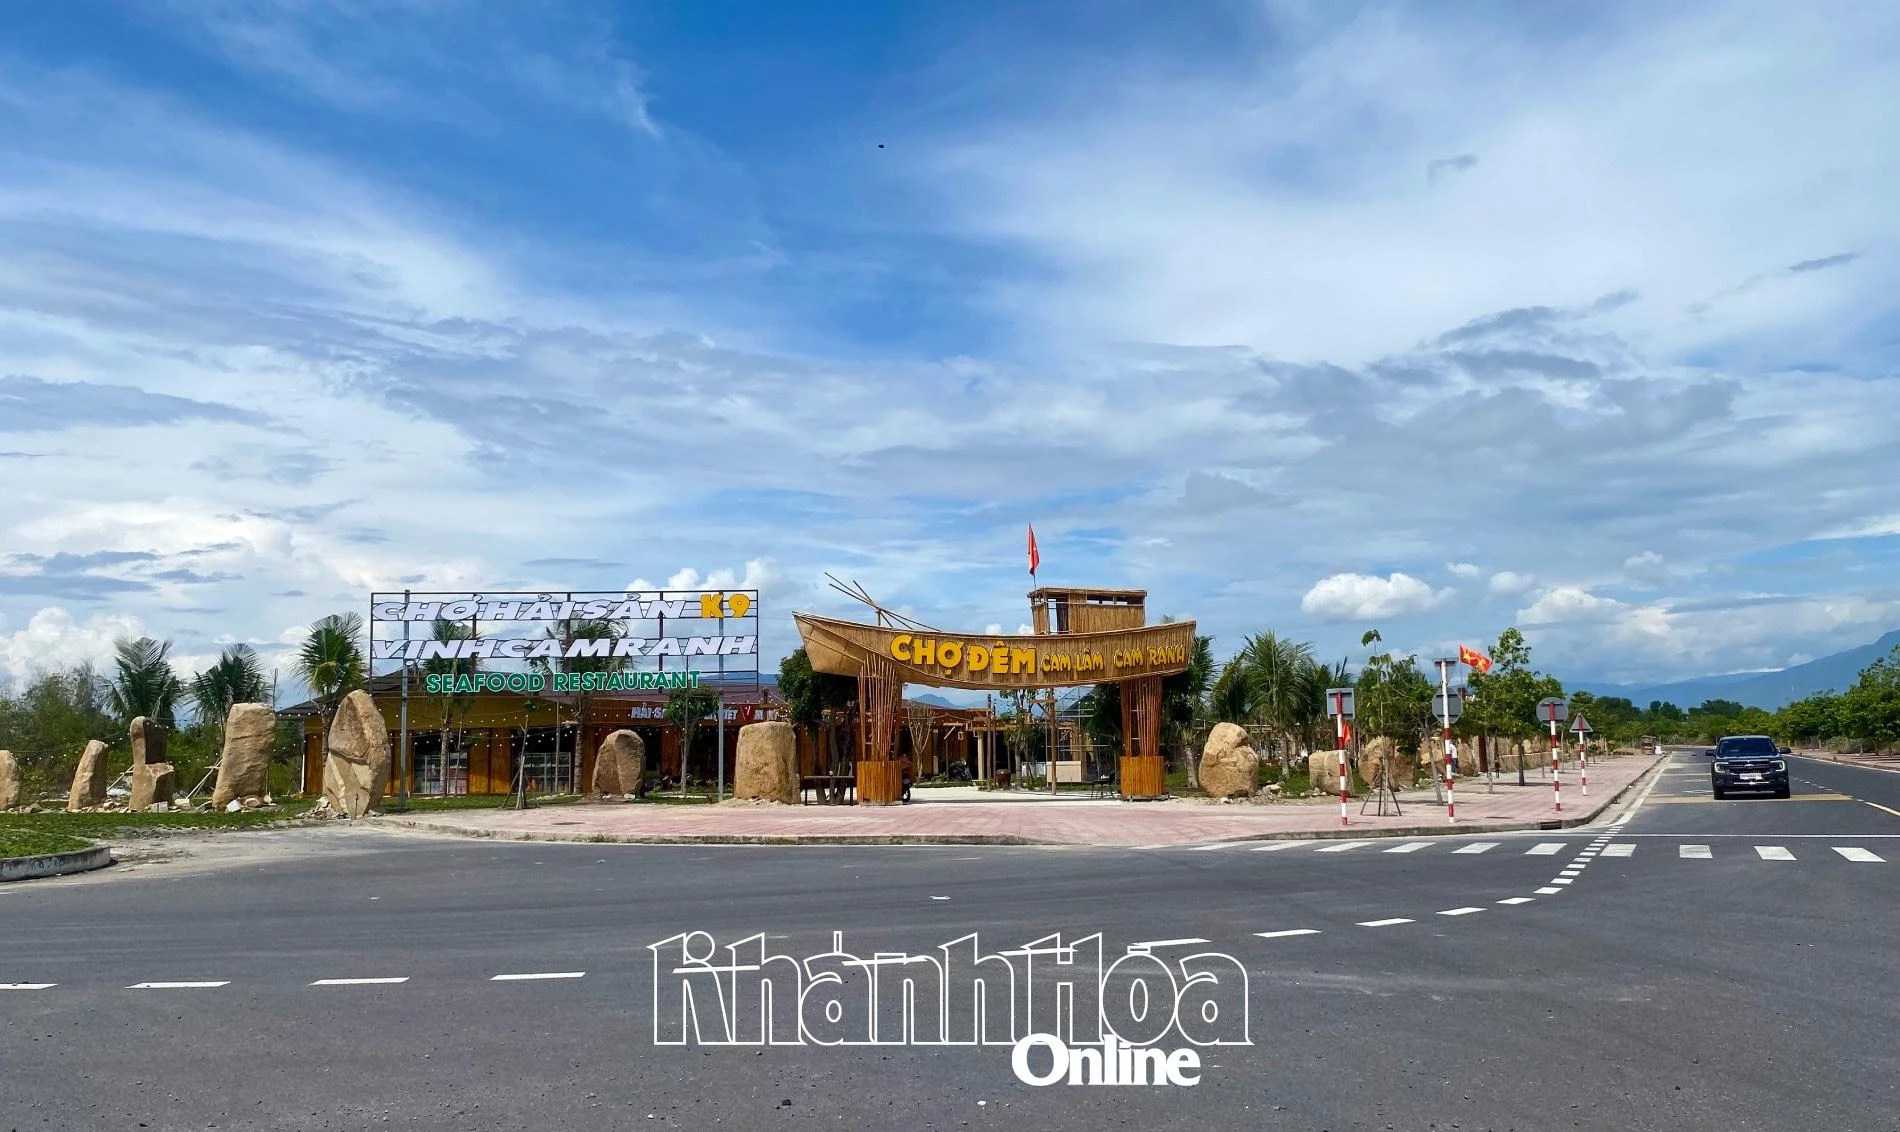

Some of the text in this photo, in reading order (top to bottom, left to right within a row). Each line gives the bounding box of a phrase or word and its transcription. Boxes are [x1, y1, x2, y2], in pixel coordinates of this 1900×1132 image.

[700, 594, 751, 619] K9
[613, 636, 756, 657] RANH
[890, 634, 1186, 676] CHỢ ĐÊM CAM LÂM CAM RANH
[426, 671, 701, 694] SEAFOOD RESTAURANT
